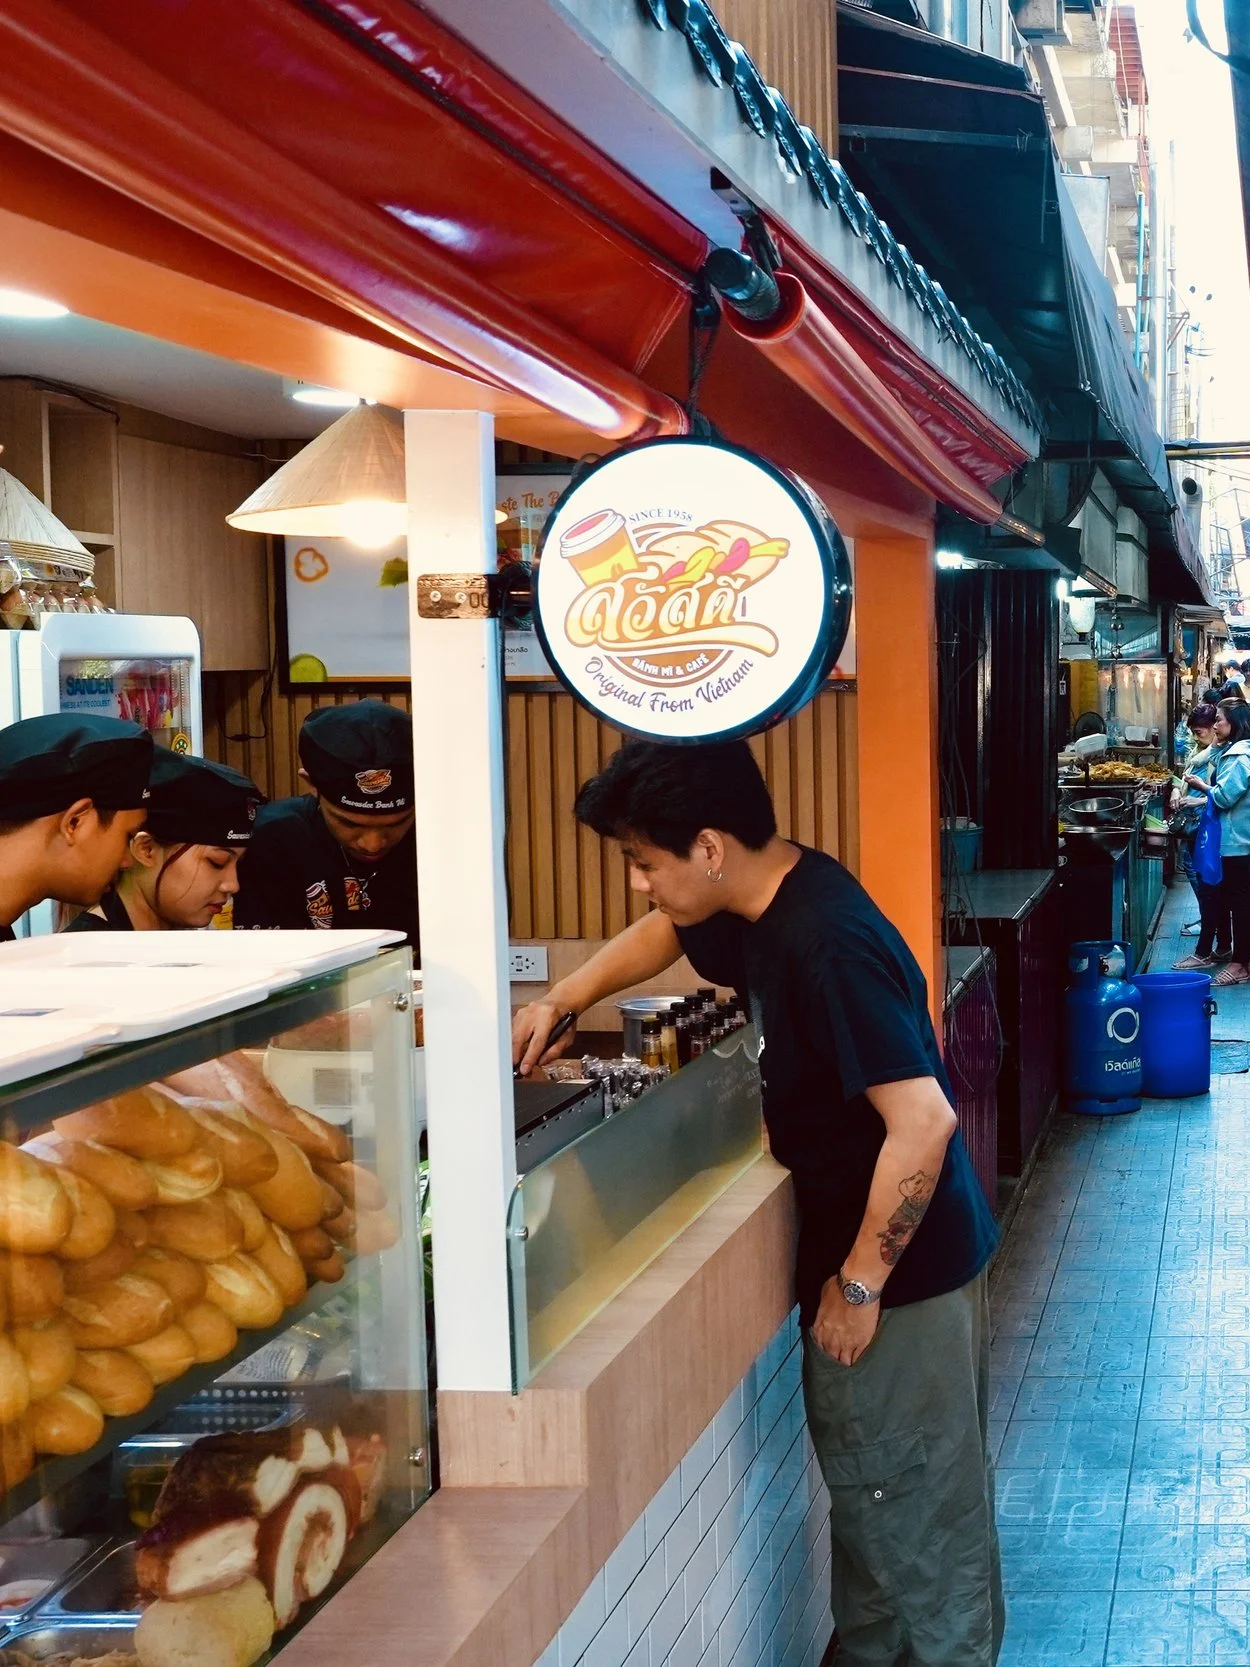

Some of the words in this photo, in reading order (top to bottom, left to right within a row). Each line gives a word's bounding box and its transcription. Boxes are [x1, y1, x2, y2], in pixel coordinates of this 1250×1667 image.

[502, 496, 518, 510] ste
[521, 492, 544, 509] The
[628, 509, 663, 522] SINCE
[668, 509, 693, 521] 1958
[565, 565, 747, 647] สวัสดี
[675, 665, 684, 676] &
[66, 676, 114, 696] SANDEN
[585, 656, 646, 708] Original
[650, 692, 694, 713] From
[695, 659, 754, 704] Vietnam
